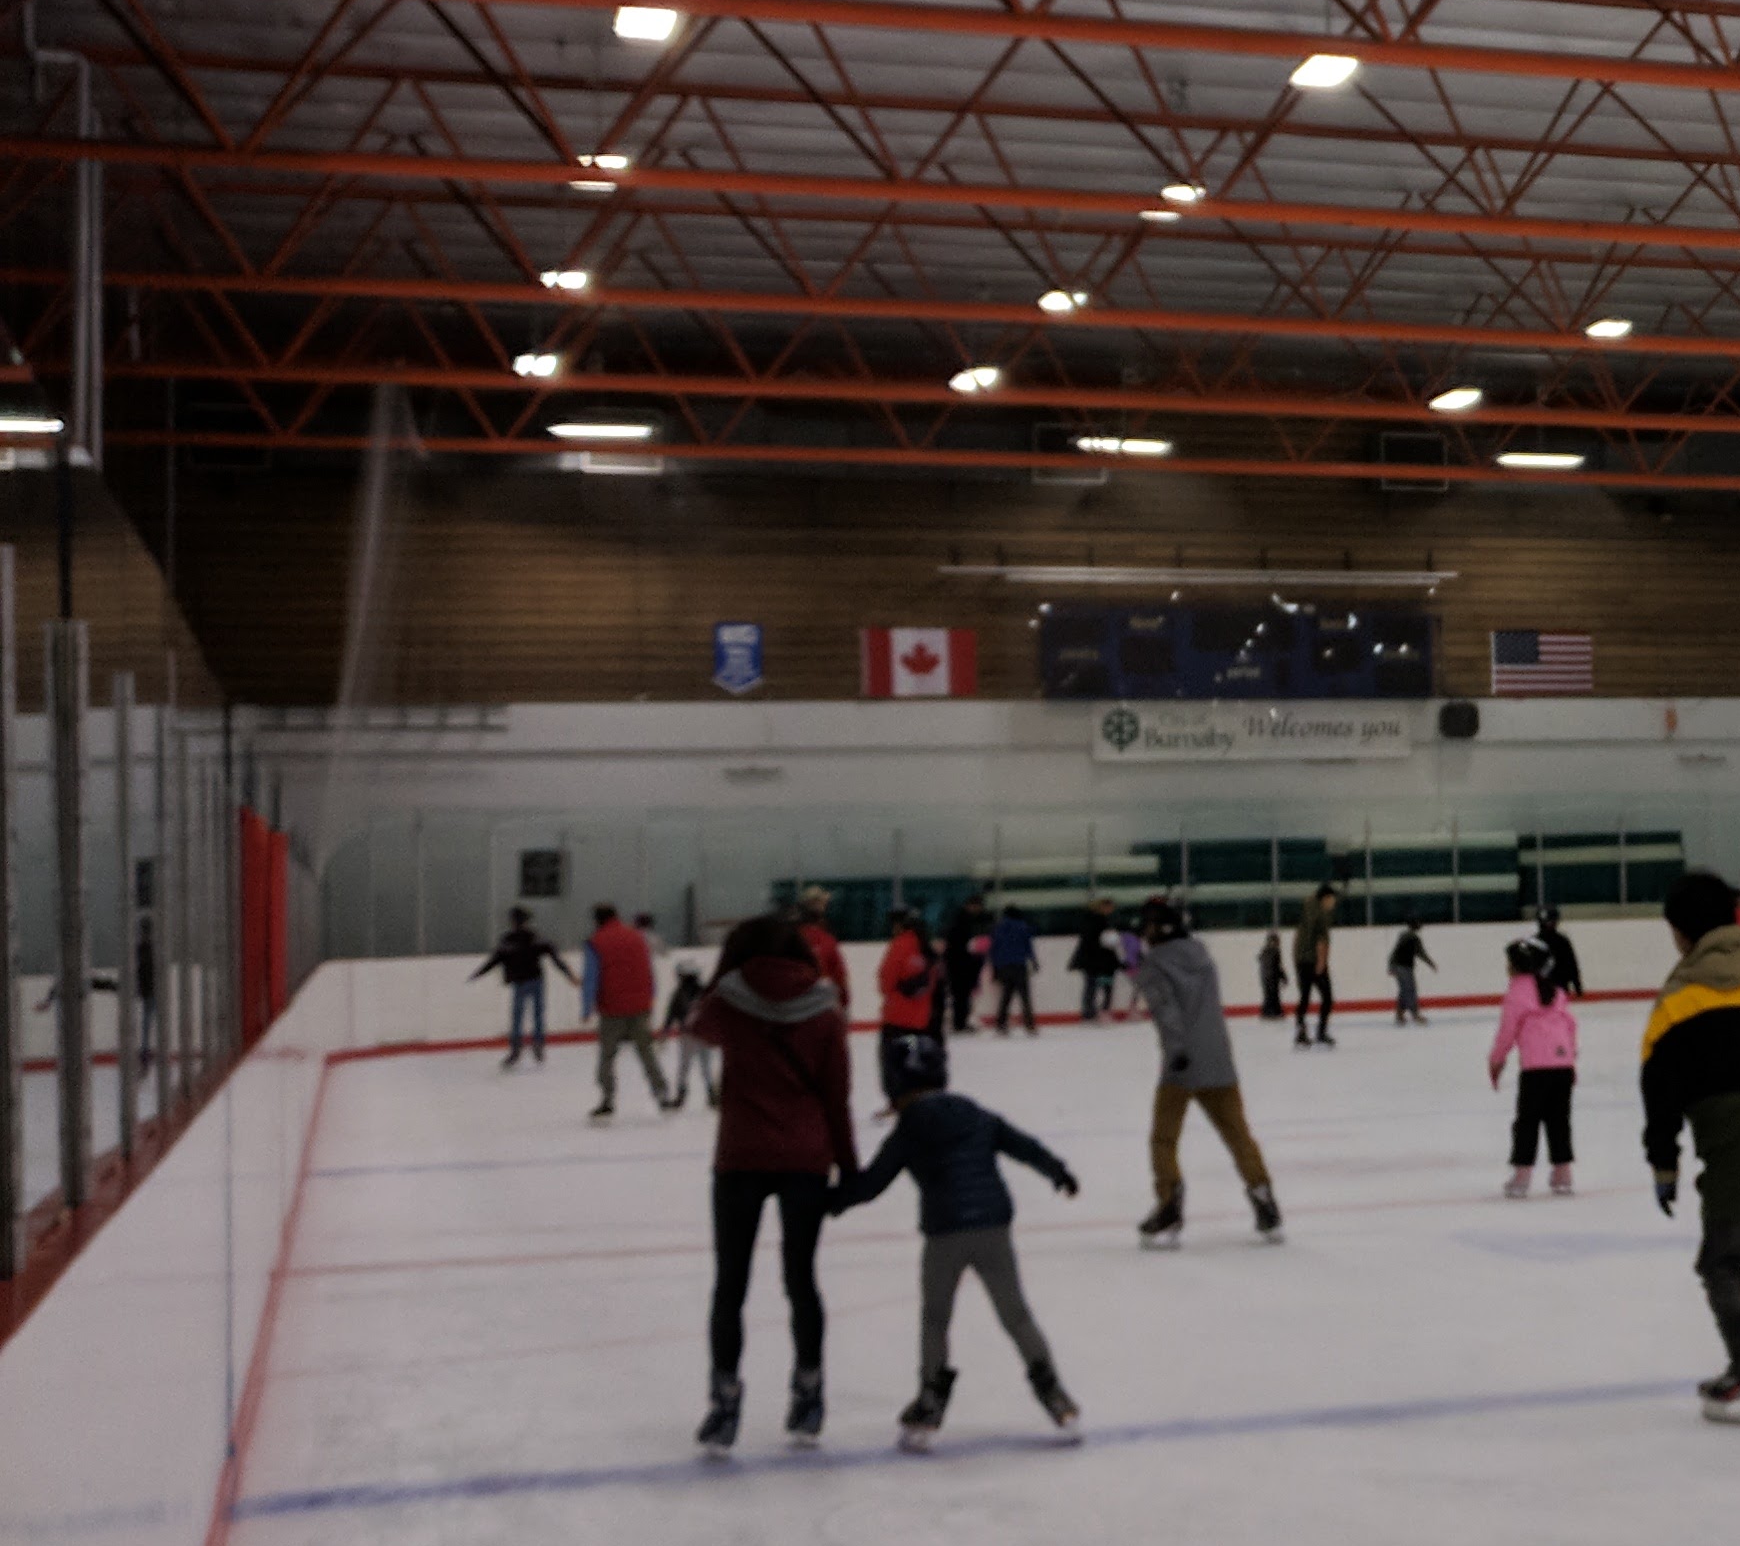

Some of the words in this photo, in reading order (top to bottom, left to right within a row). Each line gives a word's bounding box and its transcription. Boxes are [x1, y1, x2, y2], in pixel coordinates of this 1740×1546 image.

[1144, 726, 1236, 754] Burnaby
[1244, 712, 1355, 740] Welcomes
[1360, 719, 1402, 745] you
